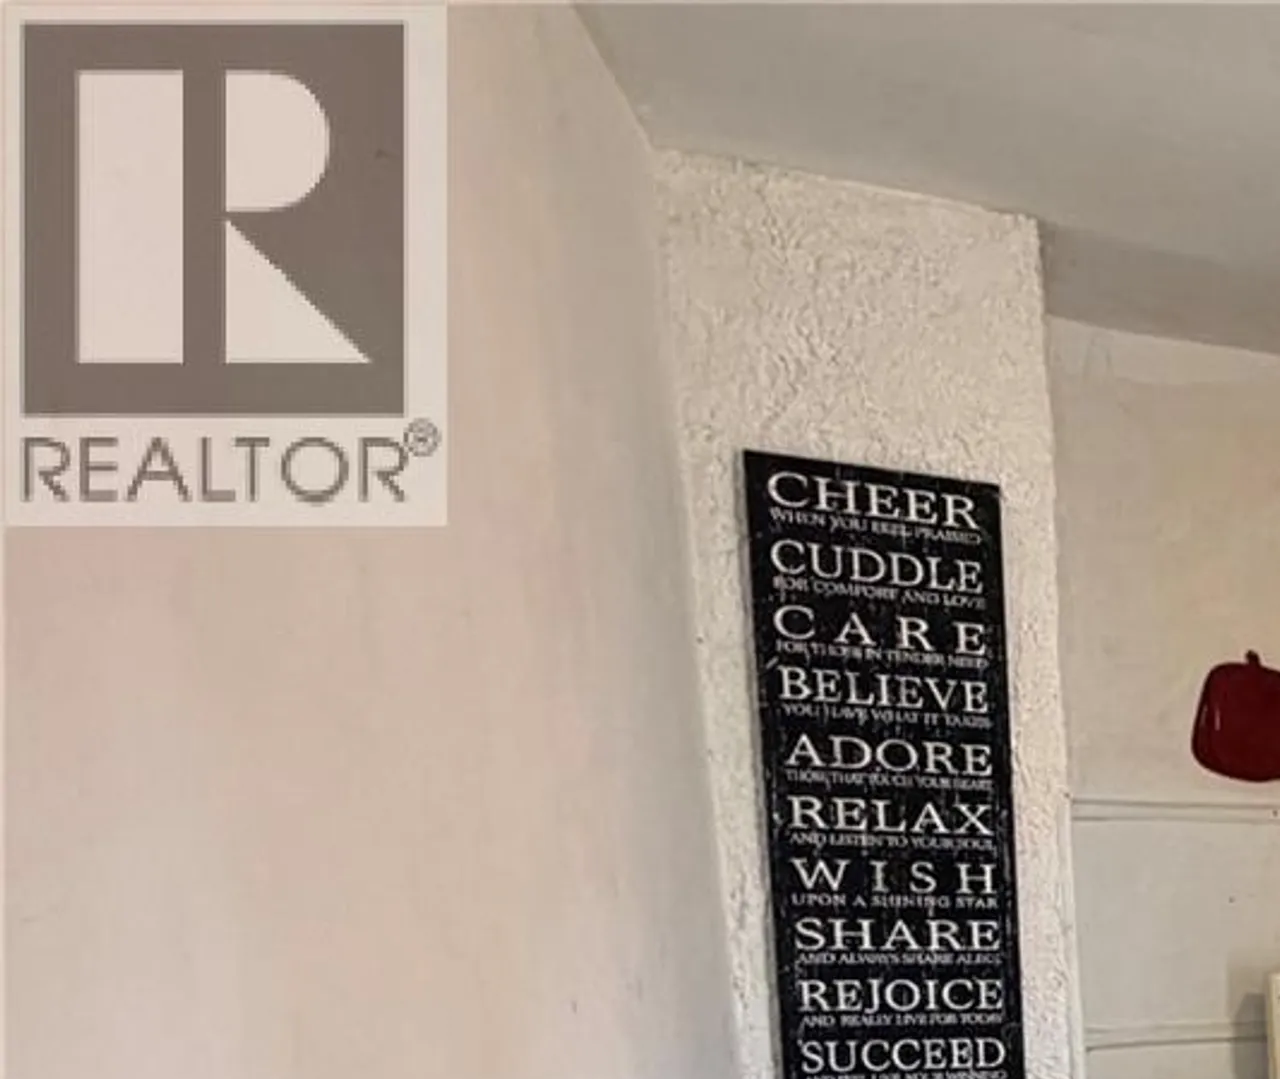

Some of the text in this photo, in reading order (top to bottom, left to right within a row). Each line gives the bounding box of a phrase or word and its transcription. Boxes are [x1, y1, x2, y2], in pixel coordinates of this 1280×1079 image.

[767, 471, 979, 529] CHEER
[828, 513, 869, 532] YOU
[770, 538, 983, 593] CUDDLE
[901, 592, 941, 605] AND
[773, 604, 987, 656] CARE
[777, 665, 988, 714] BELIEVE
[784, 733, 993, 777] ADORE
[787, 794, 994, 836] RELAX
[790, 858, 997, 894] WISH
[791, 893, 846, 907] UPON
[852, 894, 867, 907] A
[795, 917, 1001, 951] SHARE
[798, 978, 1003, 1013] REJOICE
[799, 1037, 1006, 1073] SUCCEED
